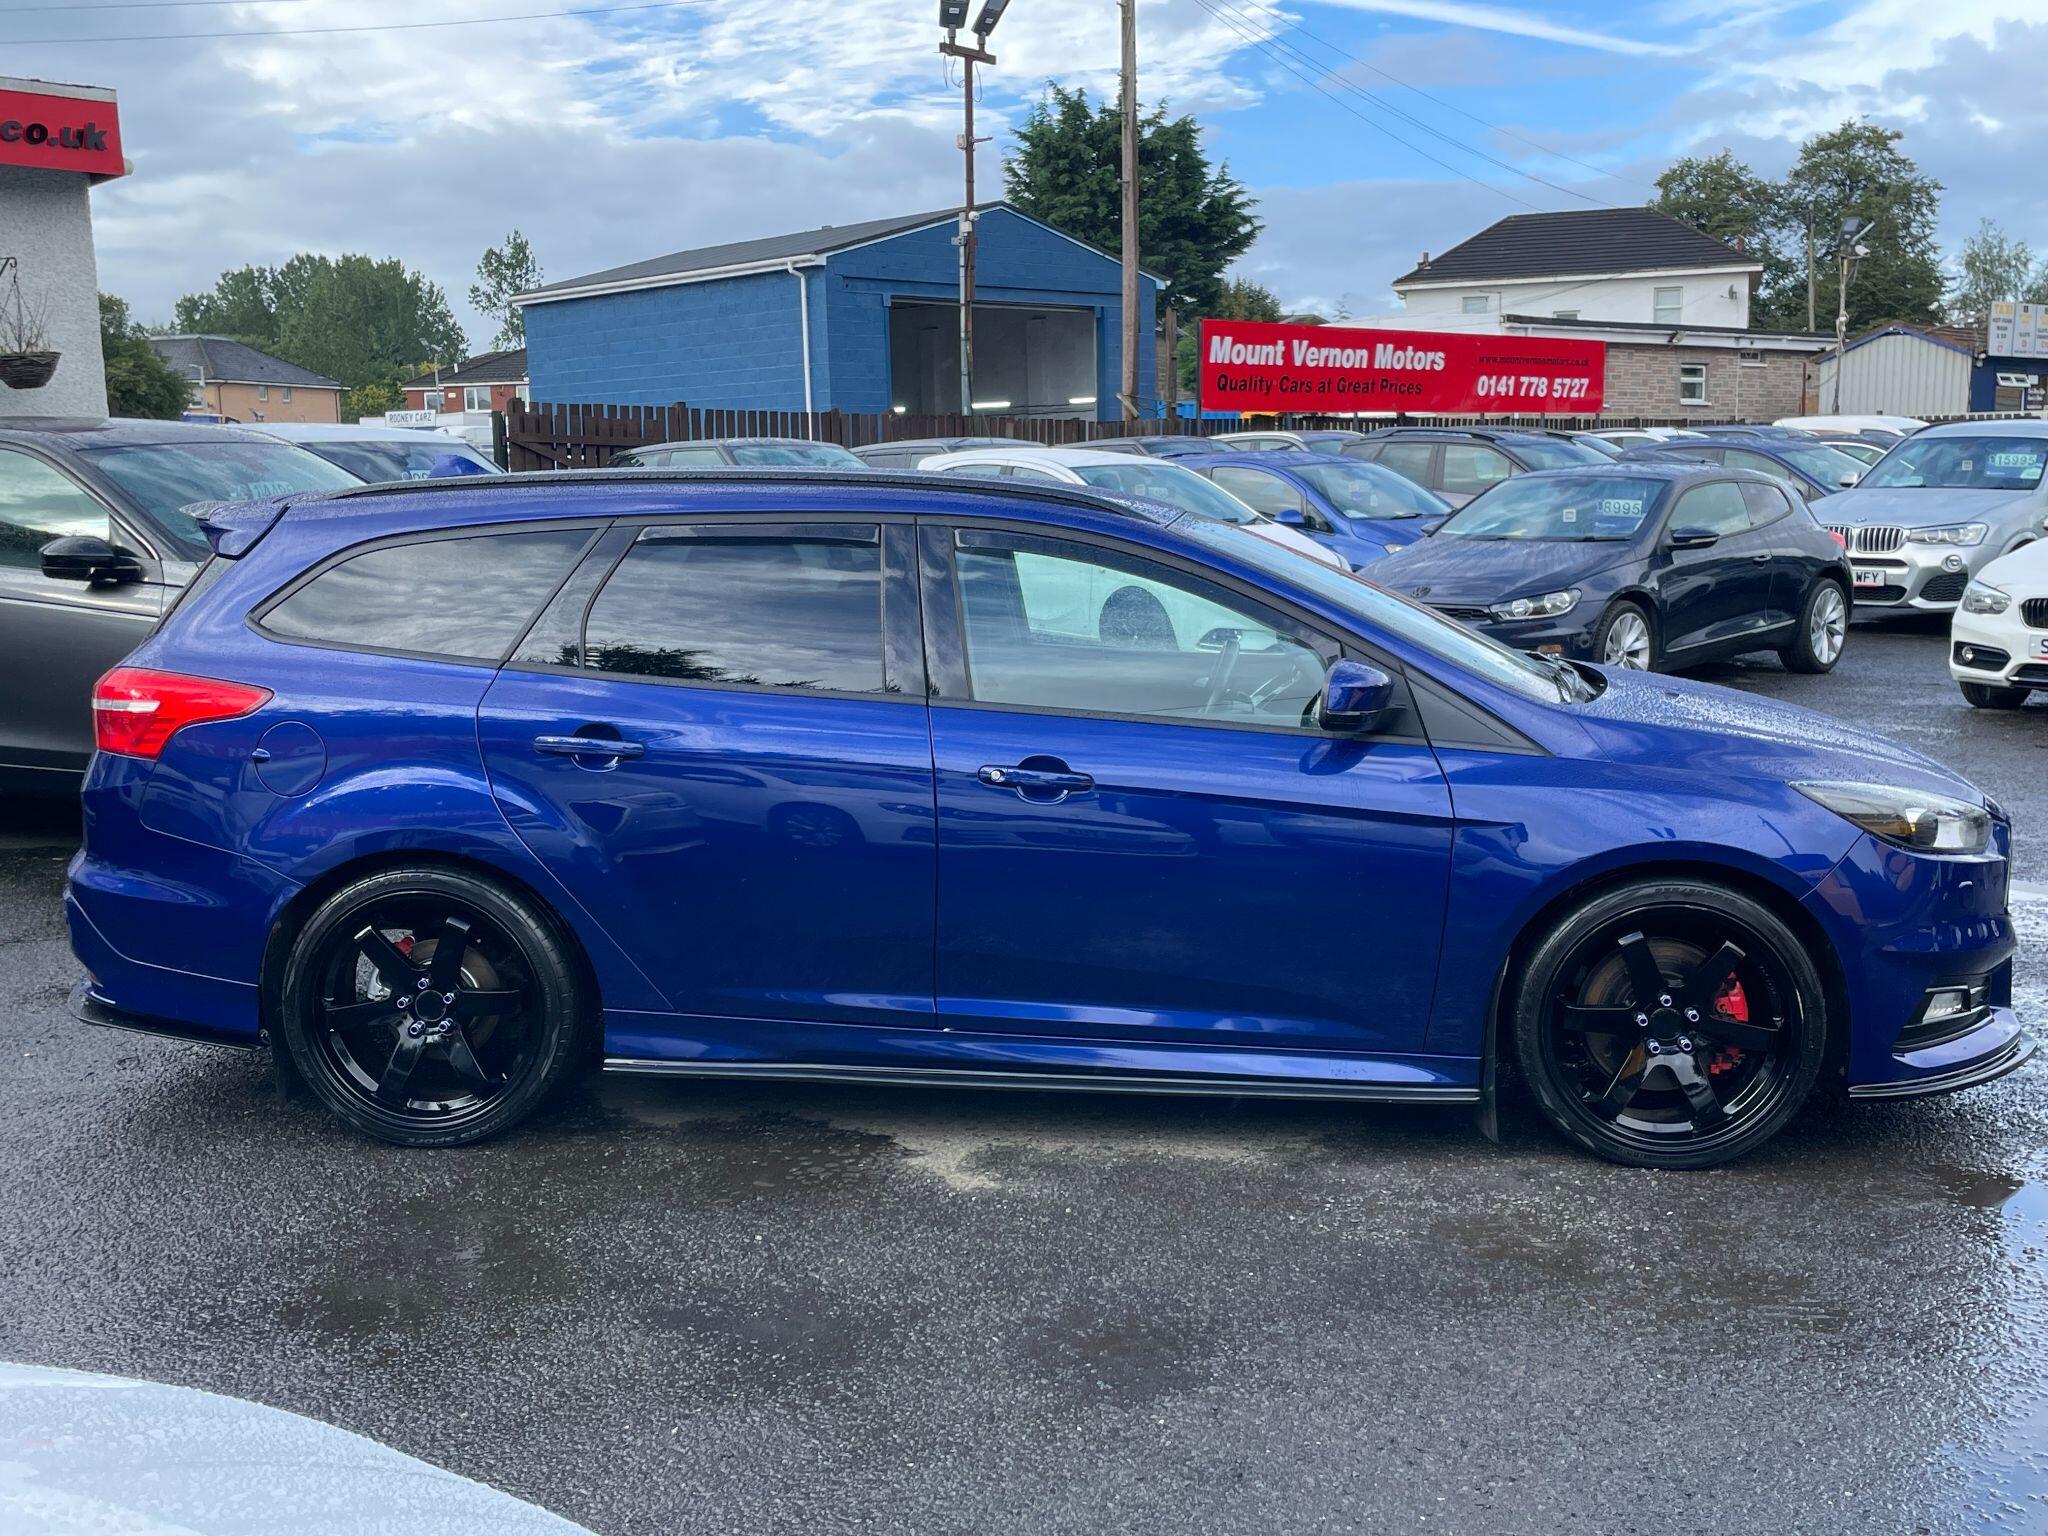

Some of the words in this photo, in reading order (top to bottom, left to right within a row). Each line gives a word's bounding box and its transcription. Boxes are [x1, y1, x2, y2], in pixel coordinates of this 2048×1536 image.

[1209, 335, 1285, 366] Mount
[1293, 339, 1369, 369] Vernon
[1374, 343, 1446, 371] Motors
[1217, 374, 1273, 396] Quality
[1280, 375, 1312, 393] Cars
[1318, 378, 1333, 394] at
[1337, 377, 1377, 394] Great
[1380, 378, 1423, 395] Prices
[1477, 375, 1516, 397] 0141
[1519, 376, 1549, 397] 778
[1552, 378, 1589, 398] 5727
[1997, 455, 2036, 466] 15995
[1603, 501, 1641, 515] 8995
[1856, 571, 1879, 583] WFY
